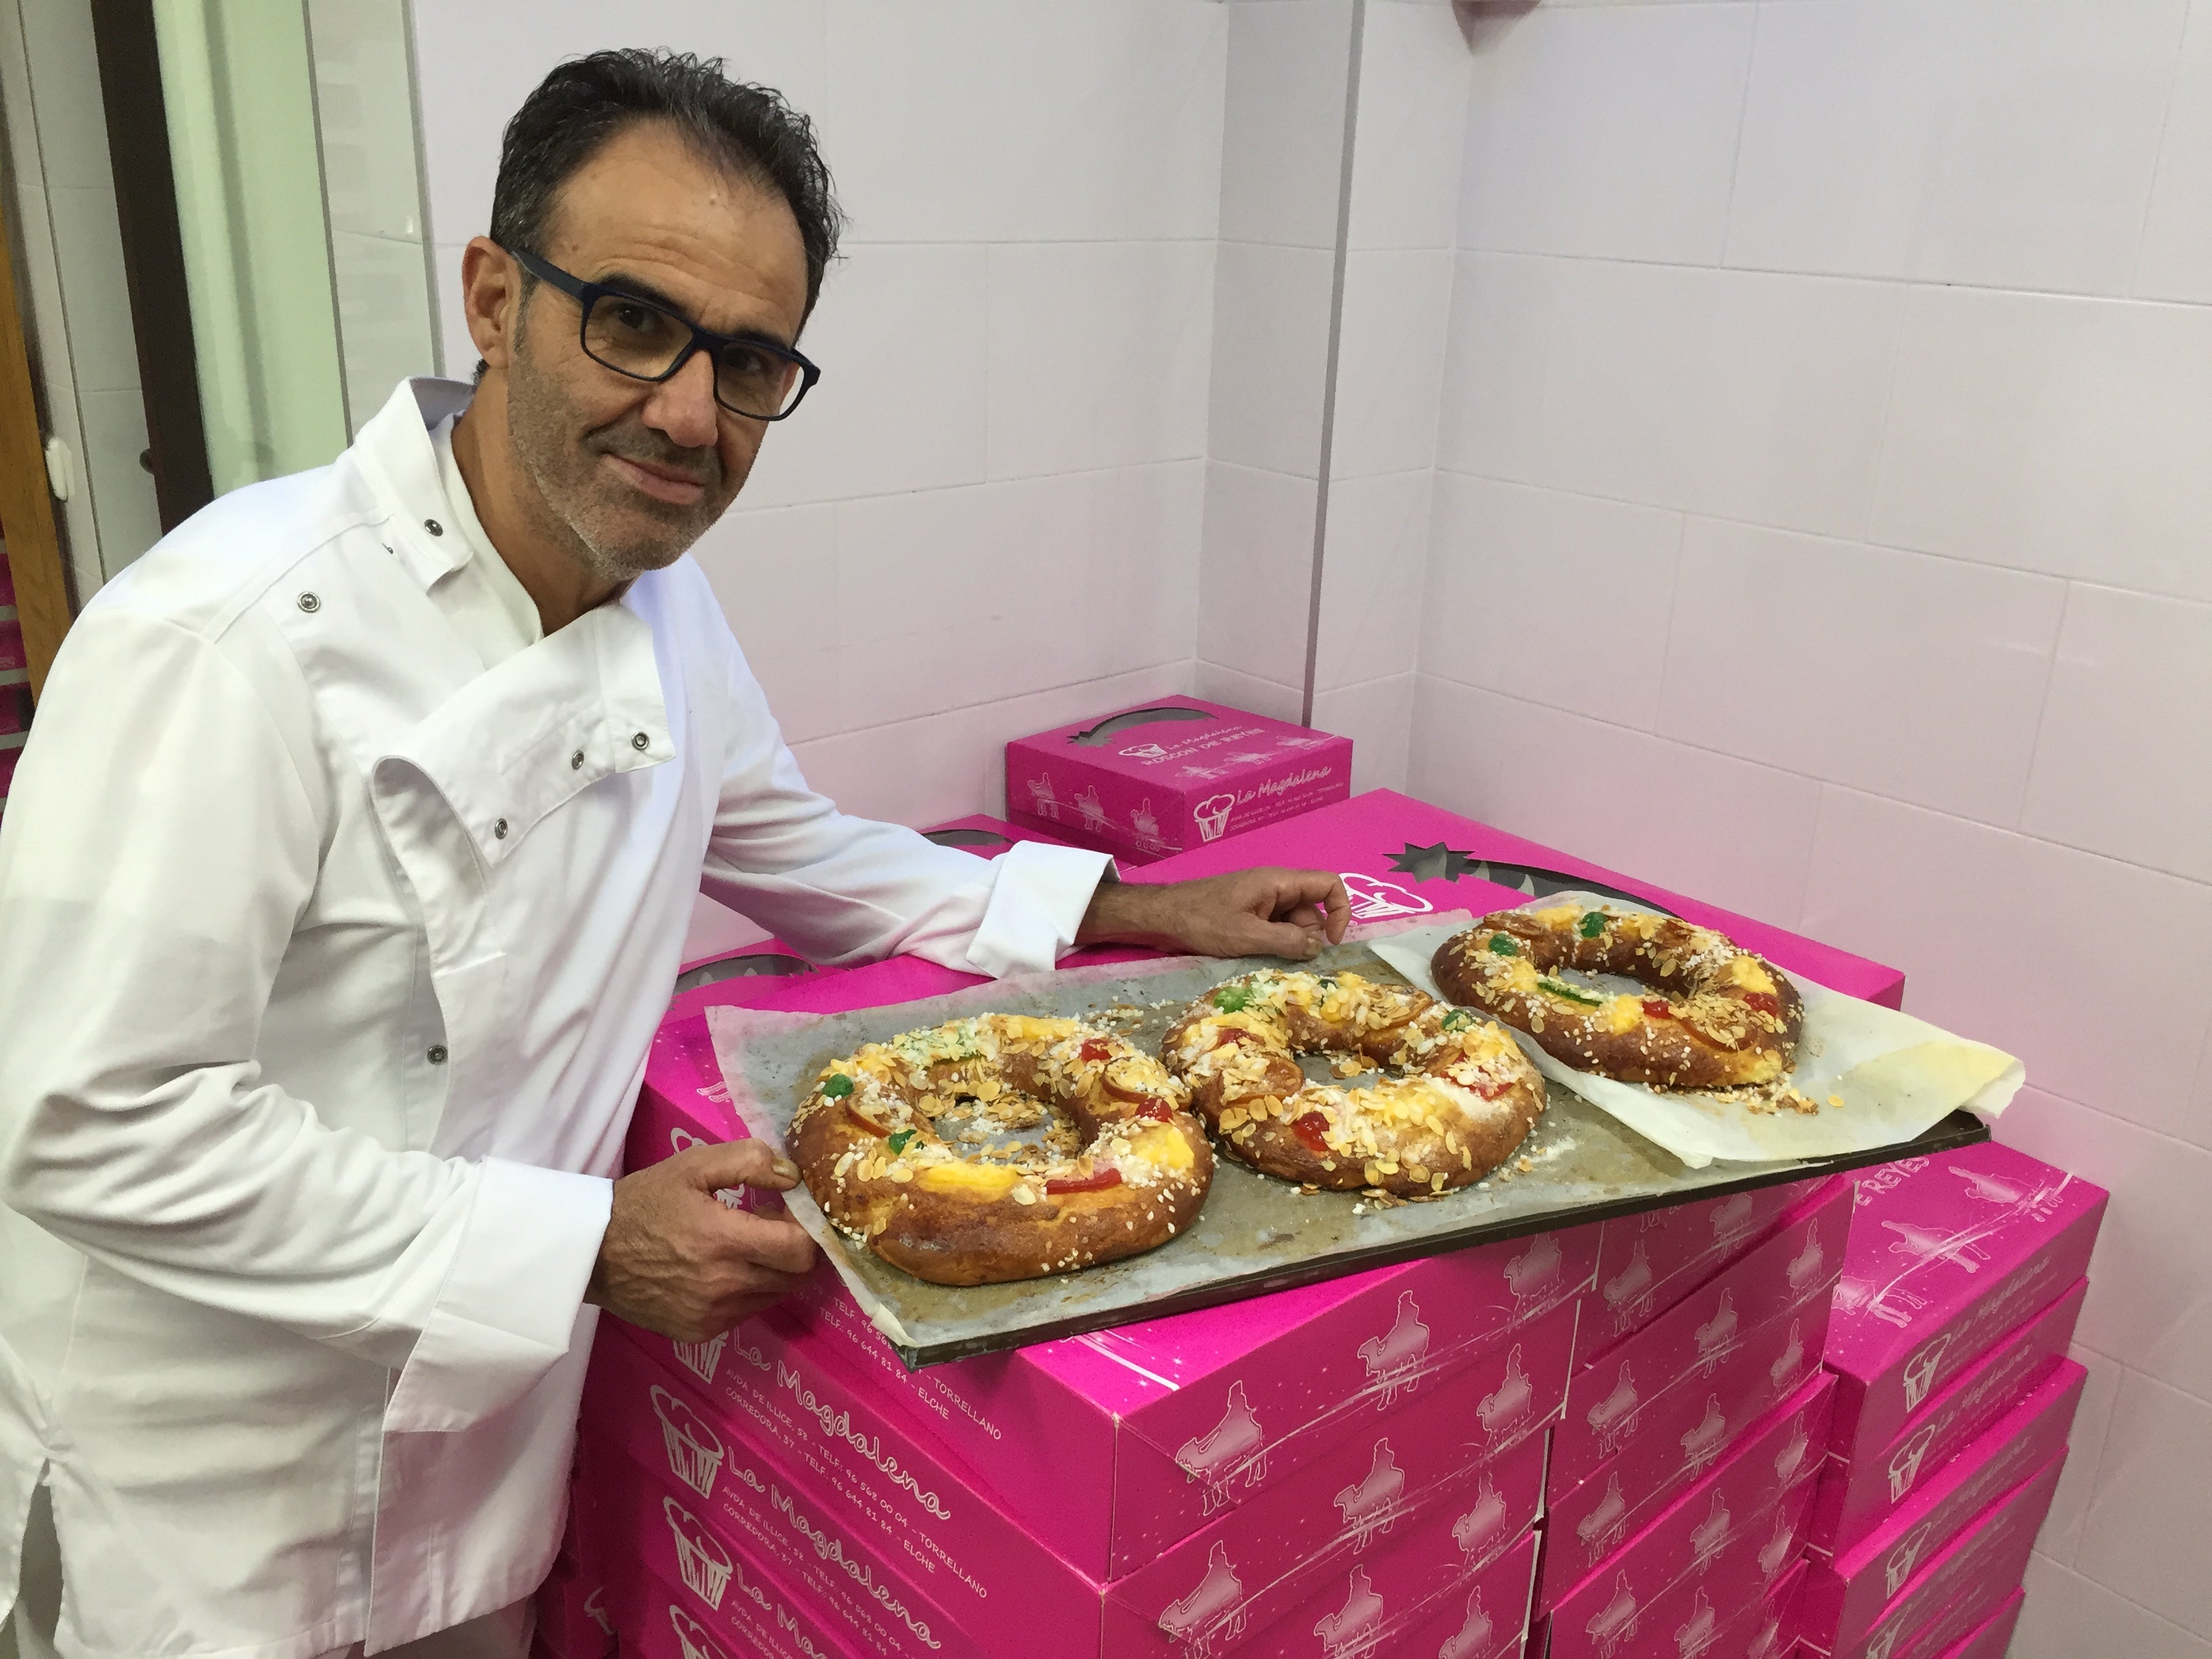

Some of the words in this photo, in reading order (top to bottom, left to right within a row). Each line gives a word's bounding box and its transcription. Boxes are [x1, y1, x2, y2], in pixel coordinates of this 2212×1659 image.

[1237, 790, 1256, 806] La
[1257, 766, 1332, 798] Magdalena
[861, 1319, 873, 1333] 96
[847, 1330, 859, 1343] 96
[861, 1341, 879, 1359] 644
[881, 1357, 893, 1372] 81
[896, 1369, 907, 1384] 84
[918, 1387, 949, 1420] ELCHE
[934, 1377, 1002, 1440] TORRELLANO
[734, 1326, 771, 1371] La
[777, 1359, 950, 1520] Magdalena
[752, 1389, 764, 1405] DE
[797, 1427, 808, 1441] 58
[846, 1469, 857, 1483] 96
[860, 1481, 878, 1501] 568
[880, 1499, 893, 1514] 00
[895, 1512, 909, 1528] 04
[919, 1532, 987, 1599] TORRELLANO
[783, 1434, 795, 1448] 37
[832, 1477, 843, 1491] 96
[846, 1489, 863, 1509] 644
[865, 1507, 878, 1521] 81
[880, 1520, 893, 1535] 84
[903, 1539, 936, 1574] ELCHE
[728, 1445, 766, 1493] La
[771, 1483, 941, 1650] Magdalena
[737, 1562, 773, 1611] La
[874, 1622, 887, 1637] 00
